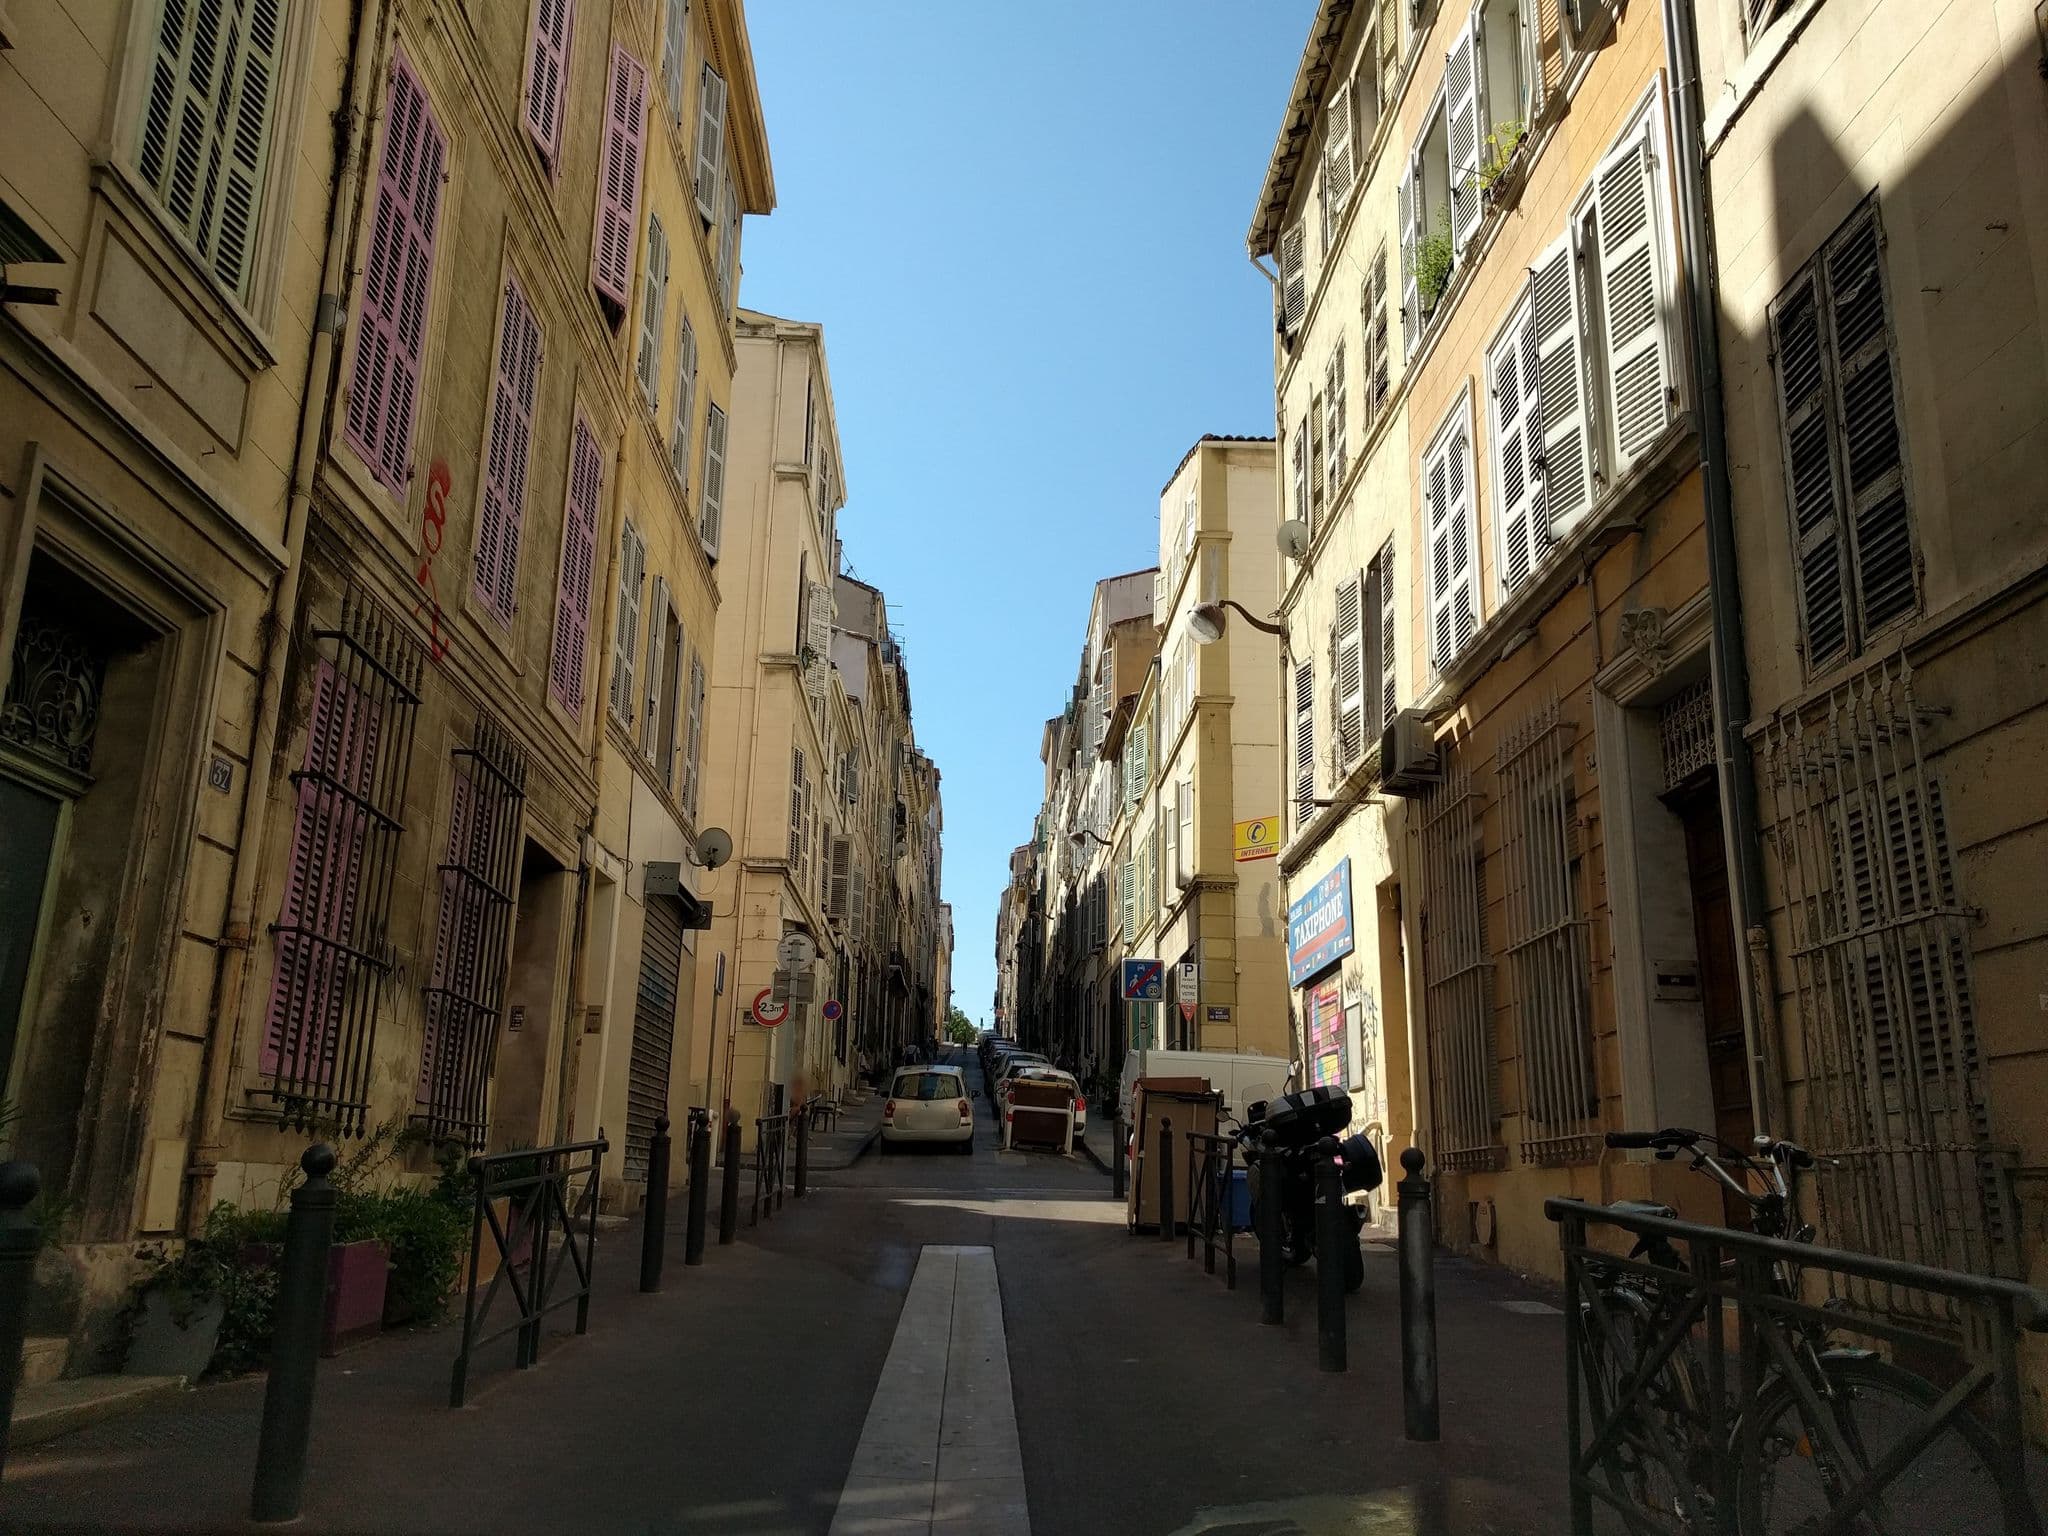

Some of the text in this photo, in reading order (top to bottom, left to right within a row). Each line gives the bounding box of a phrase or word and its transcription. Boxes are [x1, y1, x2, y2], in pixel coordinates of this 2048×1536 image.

[1240, 846, 1273, 857] INTERNET
[1294, 890, 1344, 951] TAXIPHONE
[1185, 964, 1194, 978] P
